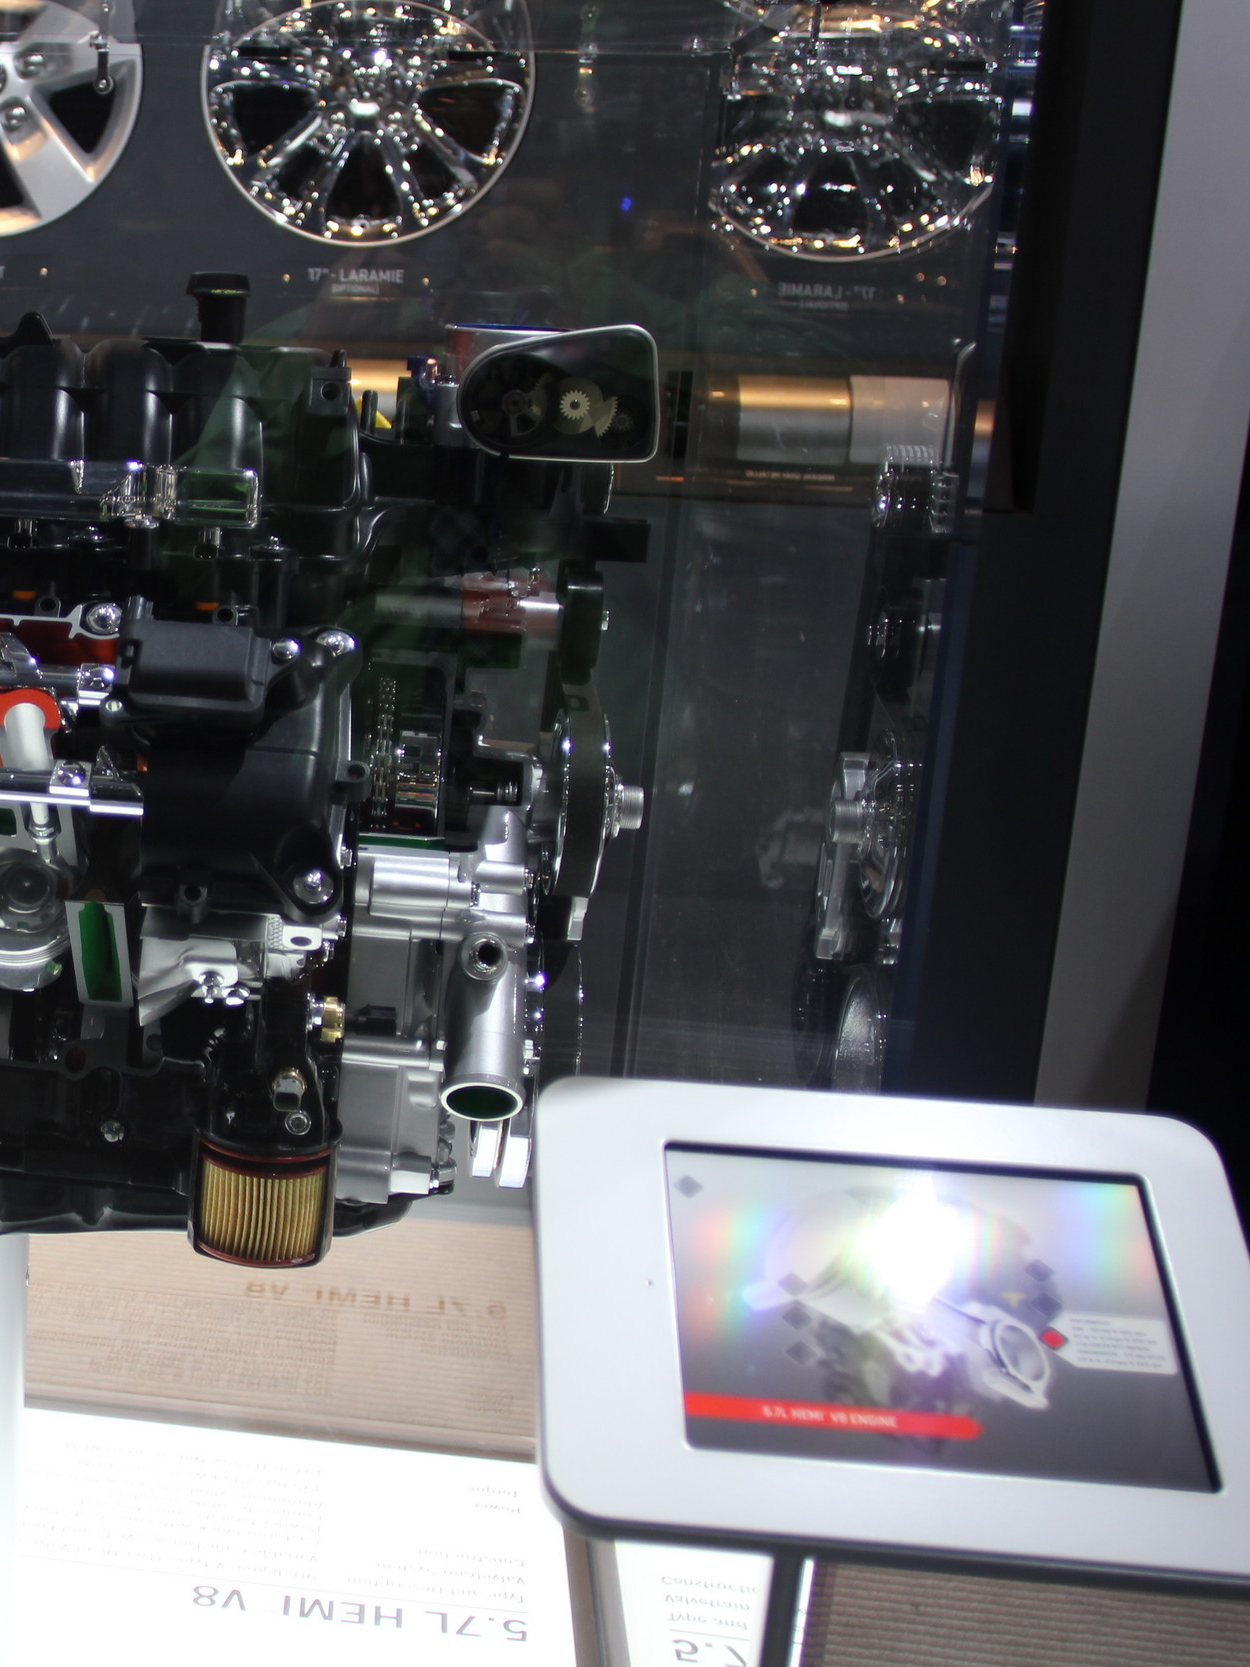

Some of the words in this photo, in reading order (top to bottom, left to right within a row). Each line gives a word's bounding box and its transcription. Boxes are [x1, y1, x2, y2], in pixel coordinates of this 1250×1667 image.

[340, 268, 405, 283] LARAMIE
[850, 1413, 897, 1428] ENGINE
[192, 1584, 247, 1612] V8
[282, 1594, 404, 1629] HEMI
[425, 1609, 528, 1643] 5.7L
